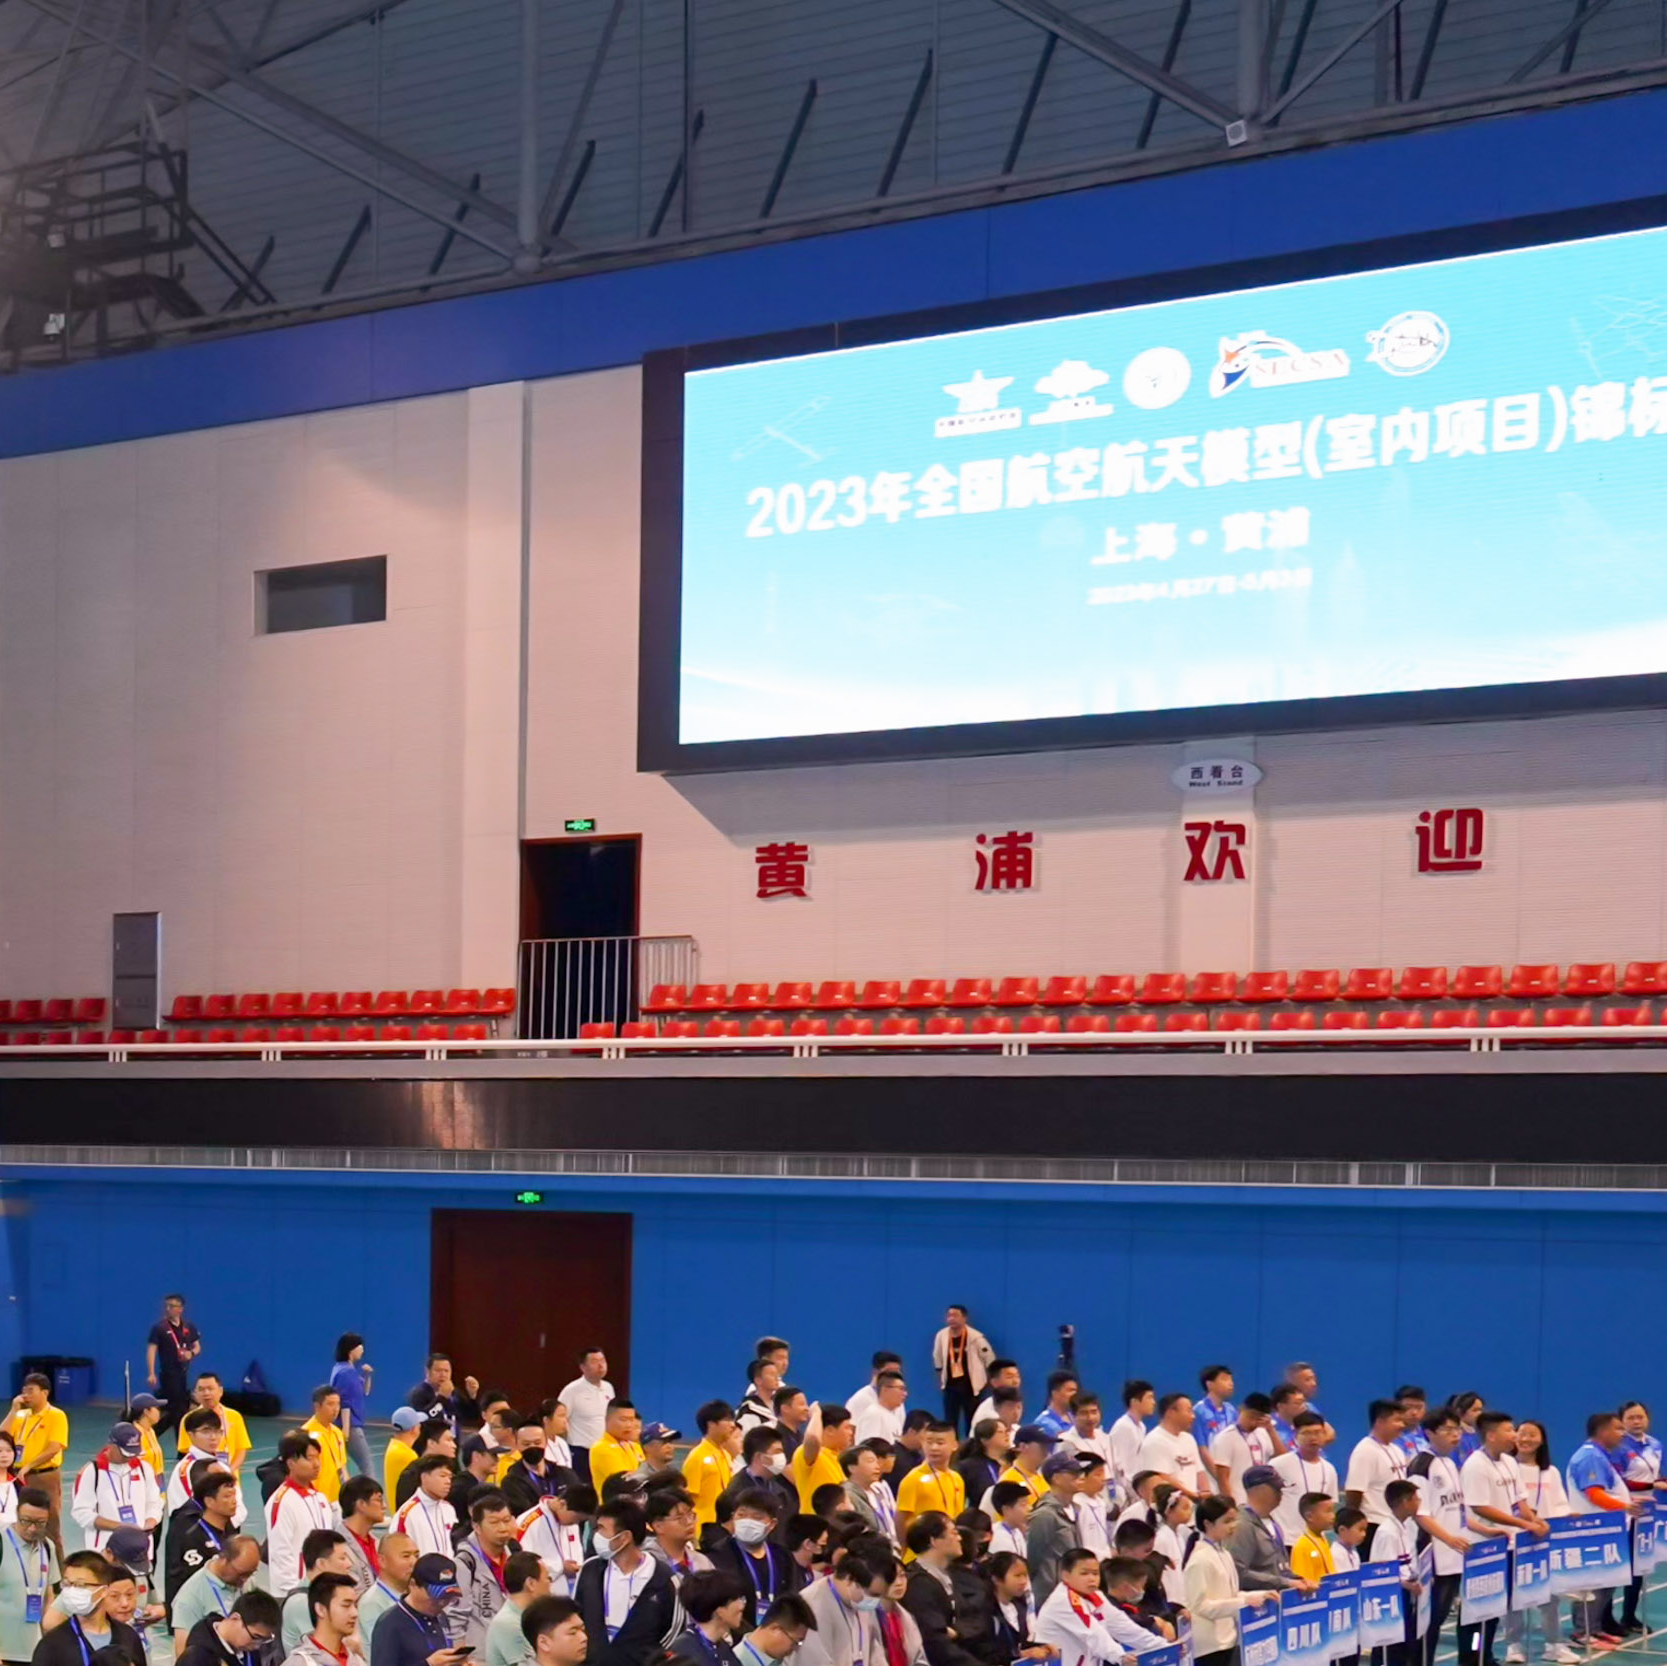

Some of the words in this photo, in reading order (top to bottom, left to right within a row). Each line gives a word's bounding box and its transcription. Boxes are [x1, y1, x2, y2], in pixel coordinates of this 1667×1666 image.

[1190, 765, 1244, 780] 西看台
[481, 1583, 492, 1618] CHINA
